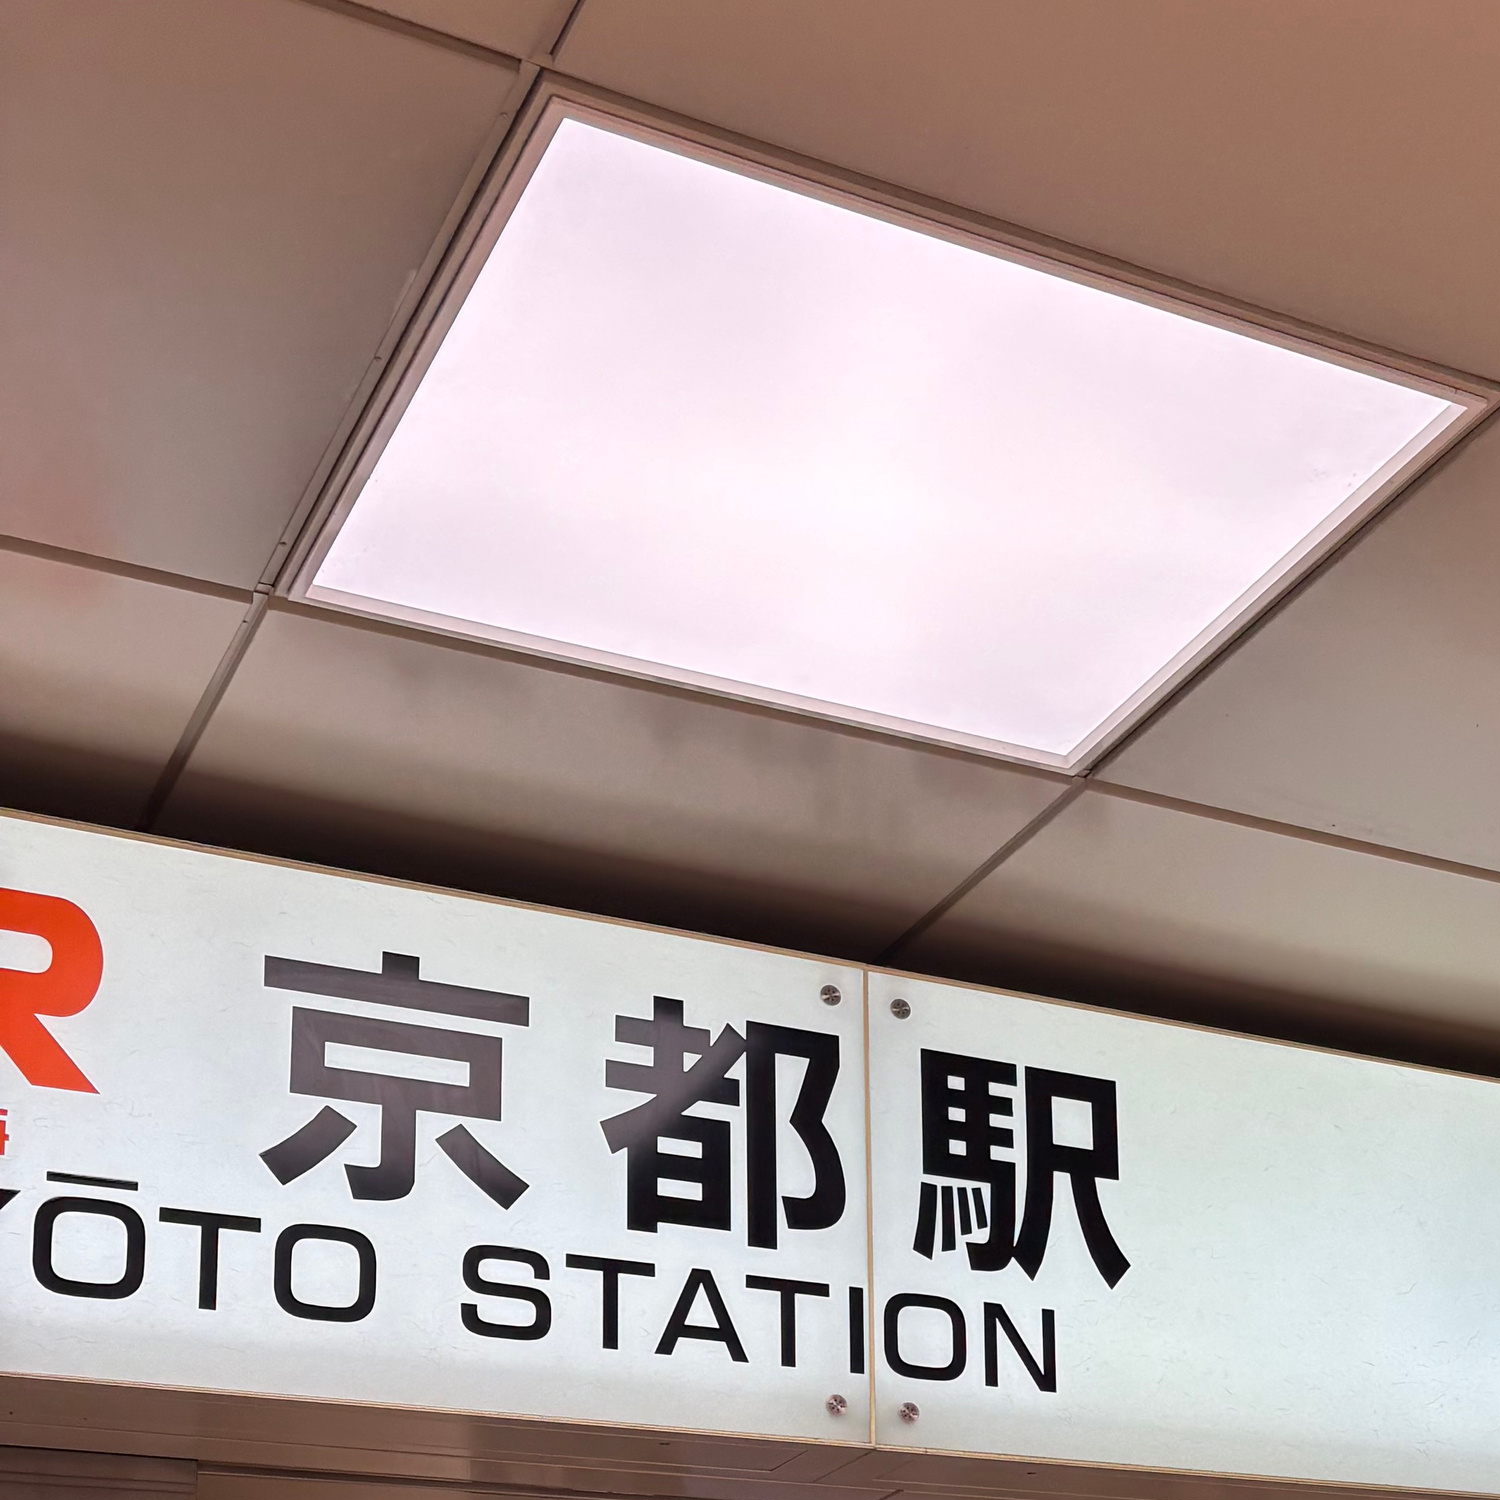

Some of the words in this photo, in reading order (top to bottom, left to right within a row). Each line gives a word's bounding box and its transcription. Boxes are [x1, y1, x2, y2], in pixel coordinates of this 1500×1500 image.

[259, 951, 1131, 1289] 京都駅
[0, 1171, 376, 1322] ŌTO
[461, 1244, 1059, 1393] STATION
